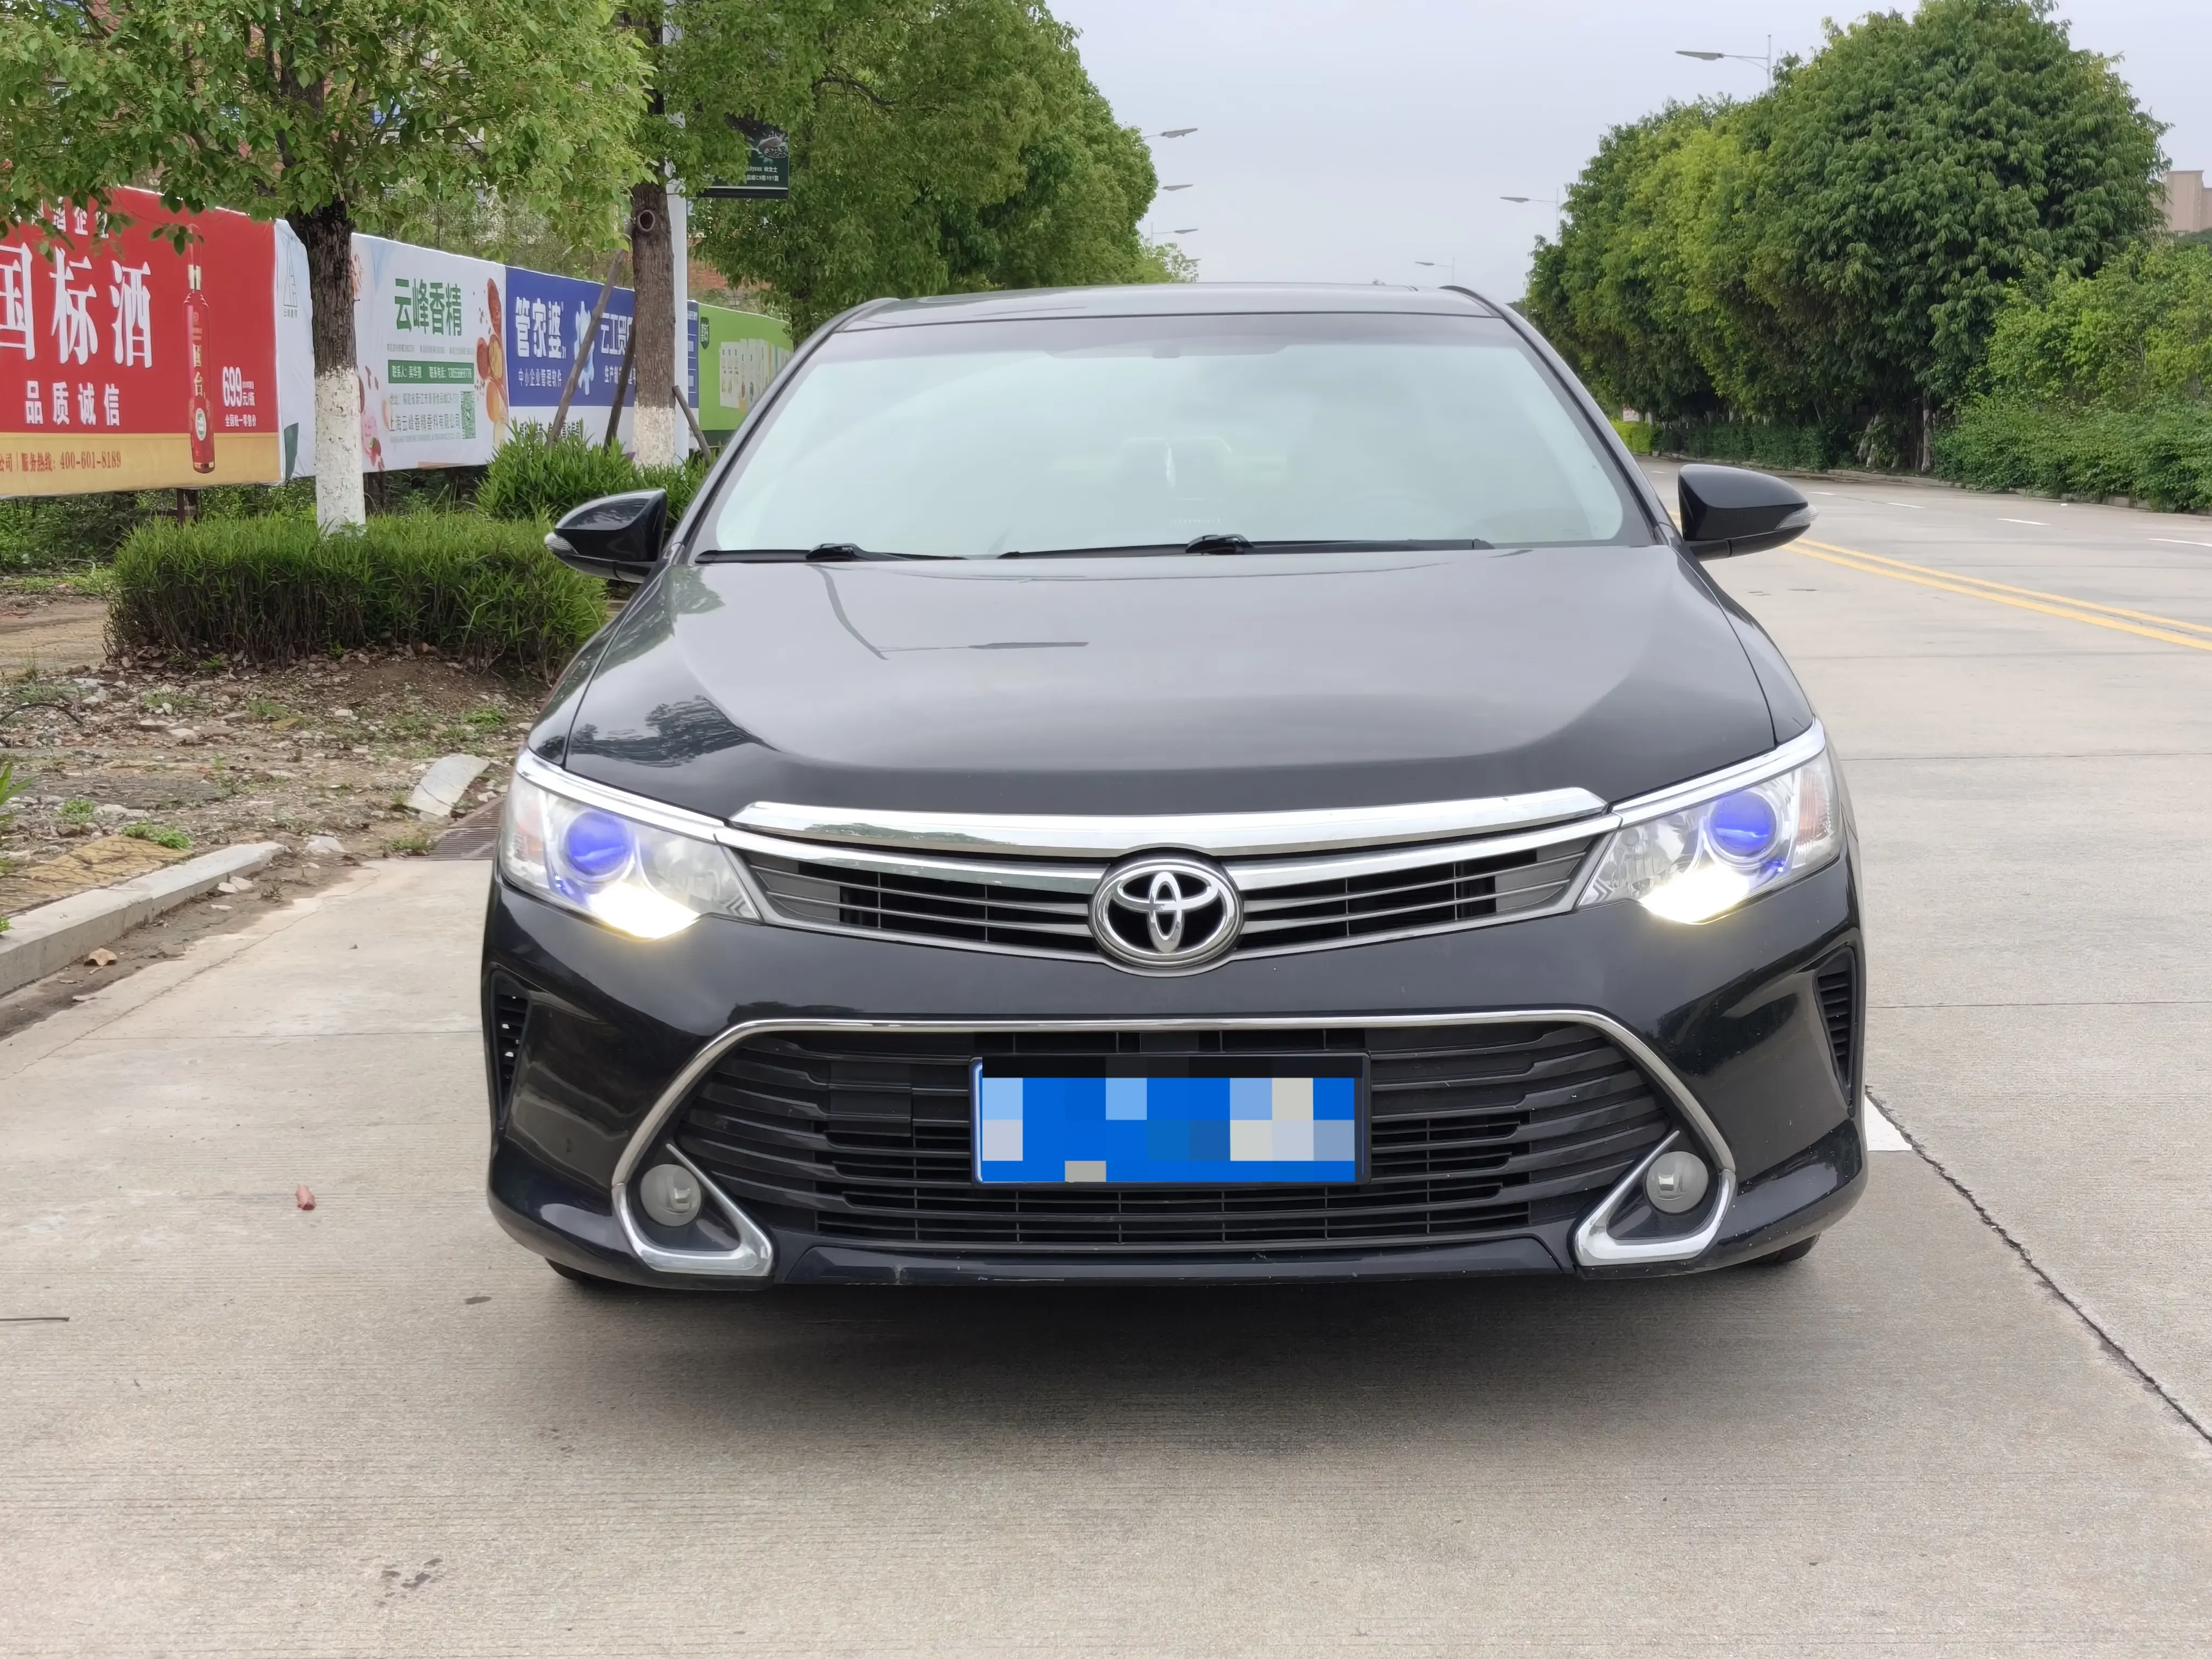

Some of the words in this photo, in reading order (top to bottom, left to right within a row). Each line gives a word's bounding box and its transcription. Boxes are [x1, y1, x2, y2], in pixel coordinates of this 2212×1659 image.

[395, 278, 462, 336] 云峰香精
[515, 296, 562, 359] 管家婆
[222, 366, 242, 407] 699
[518, 368, 562, 387] 中小企业管理软件
[25, 381, 120, 426] 品质诚信
[60, 451, 122, 469] 400-601-8189
